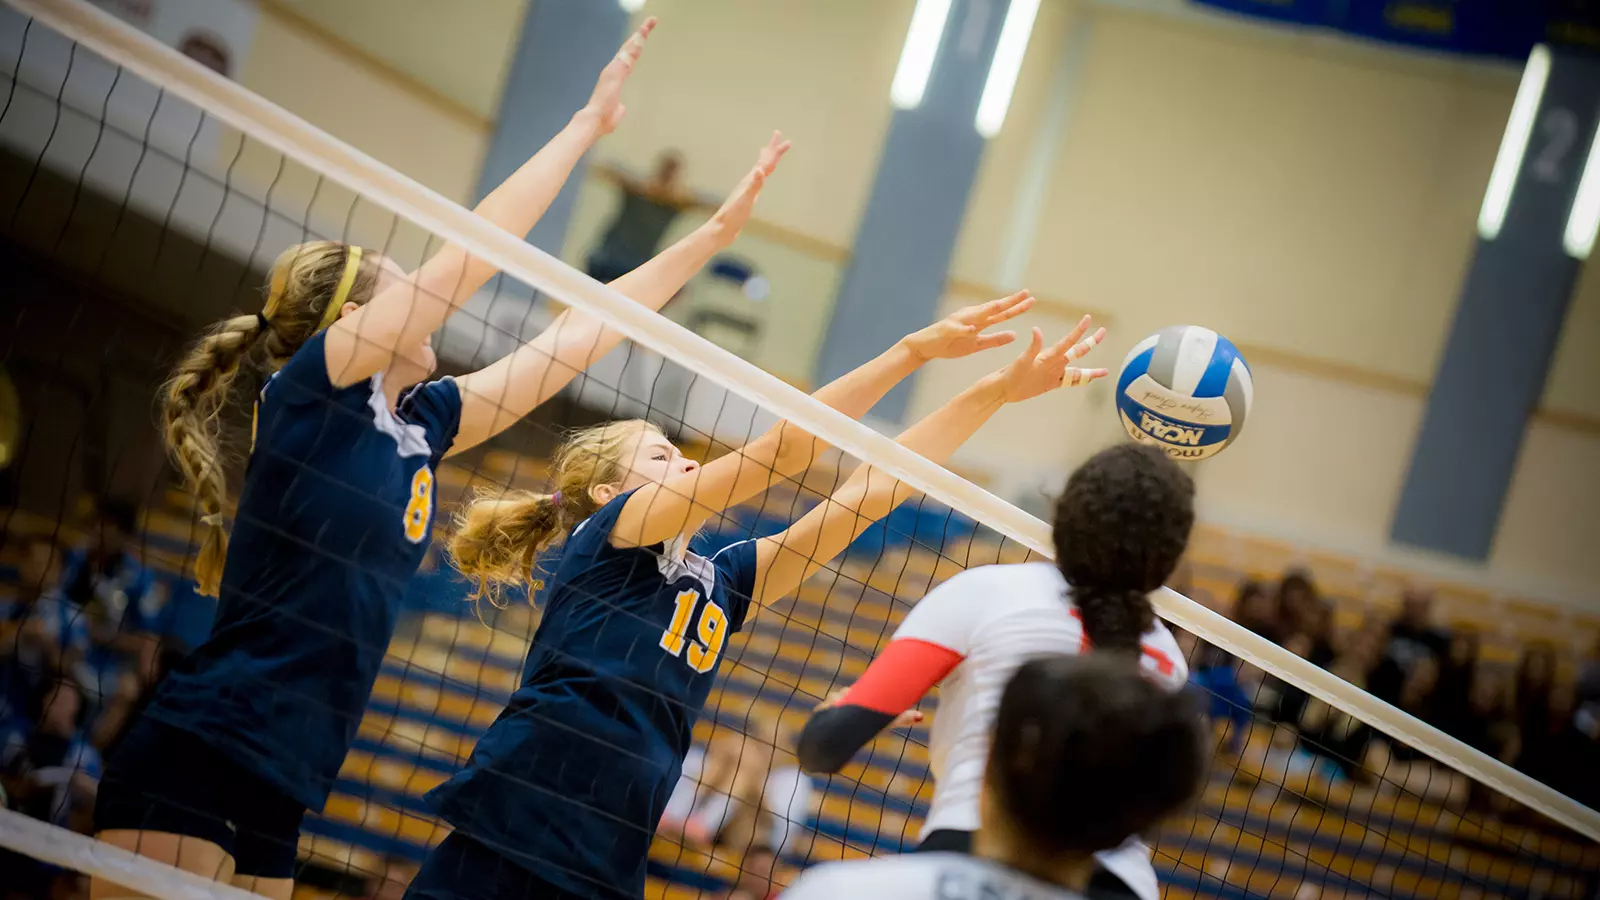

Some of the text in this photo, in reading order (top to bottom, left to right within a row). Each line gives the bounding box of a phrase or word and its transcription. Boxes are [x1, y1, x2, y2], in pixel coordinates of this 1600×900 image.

[1532, 105, 1579, 182] 2
[1141, 413, 1204, 445] NCAA
[403, 463, 434, 544] 8
[659, 587, 728, 674] 19
